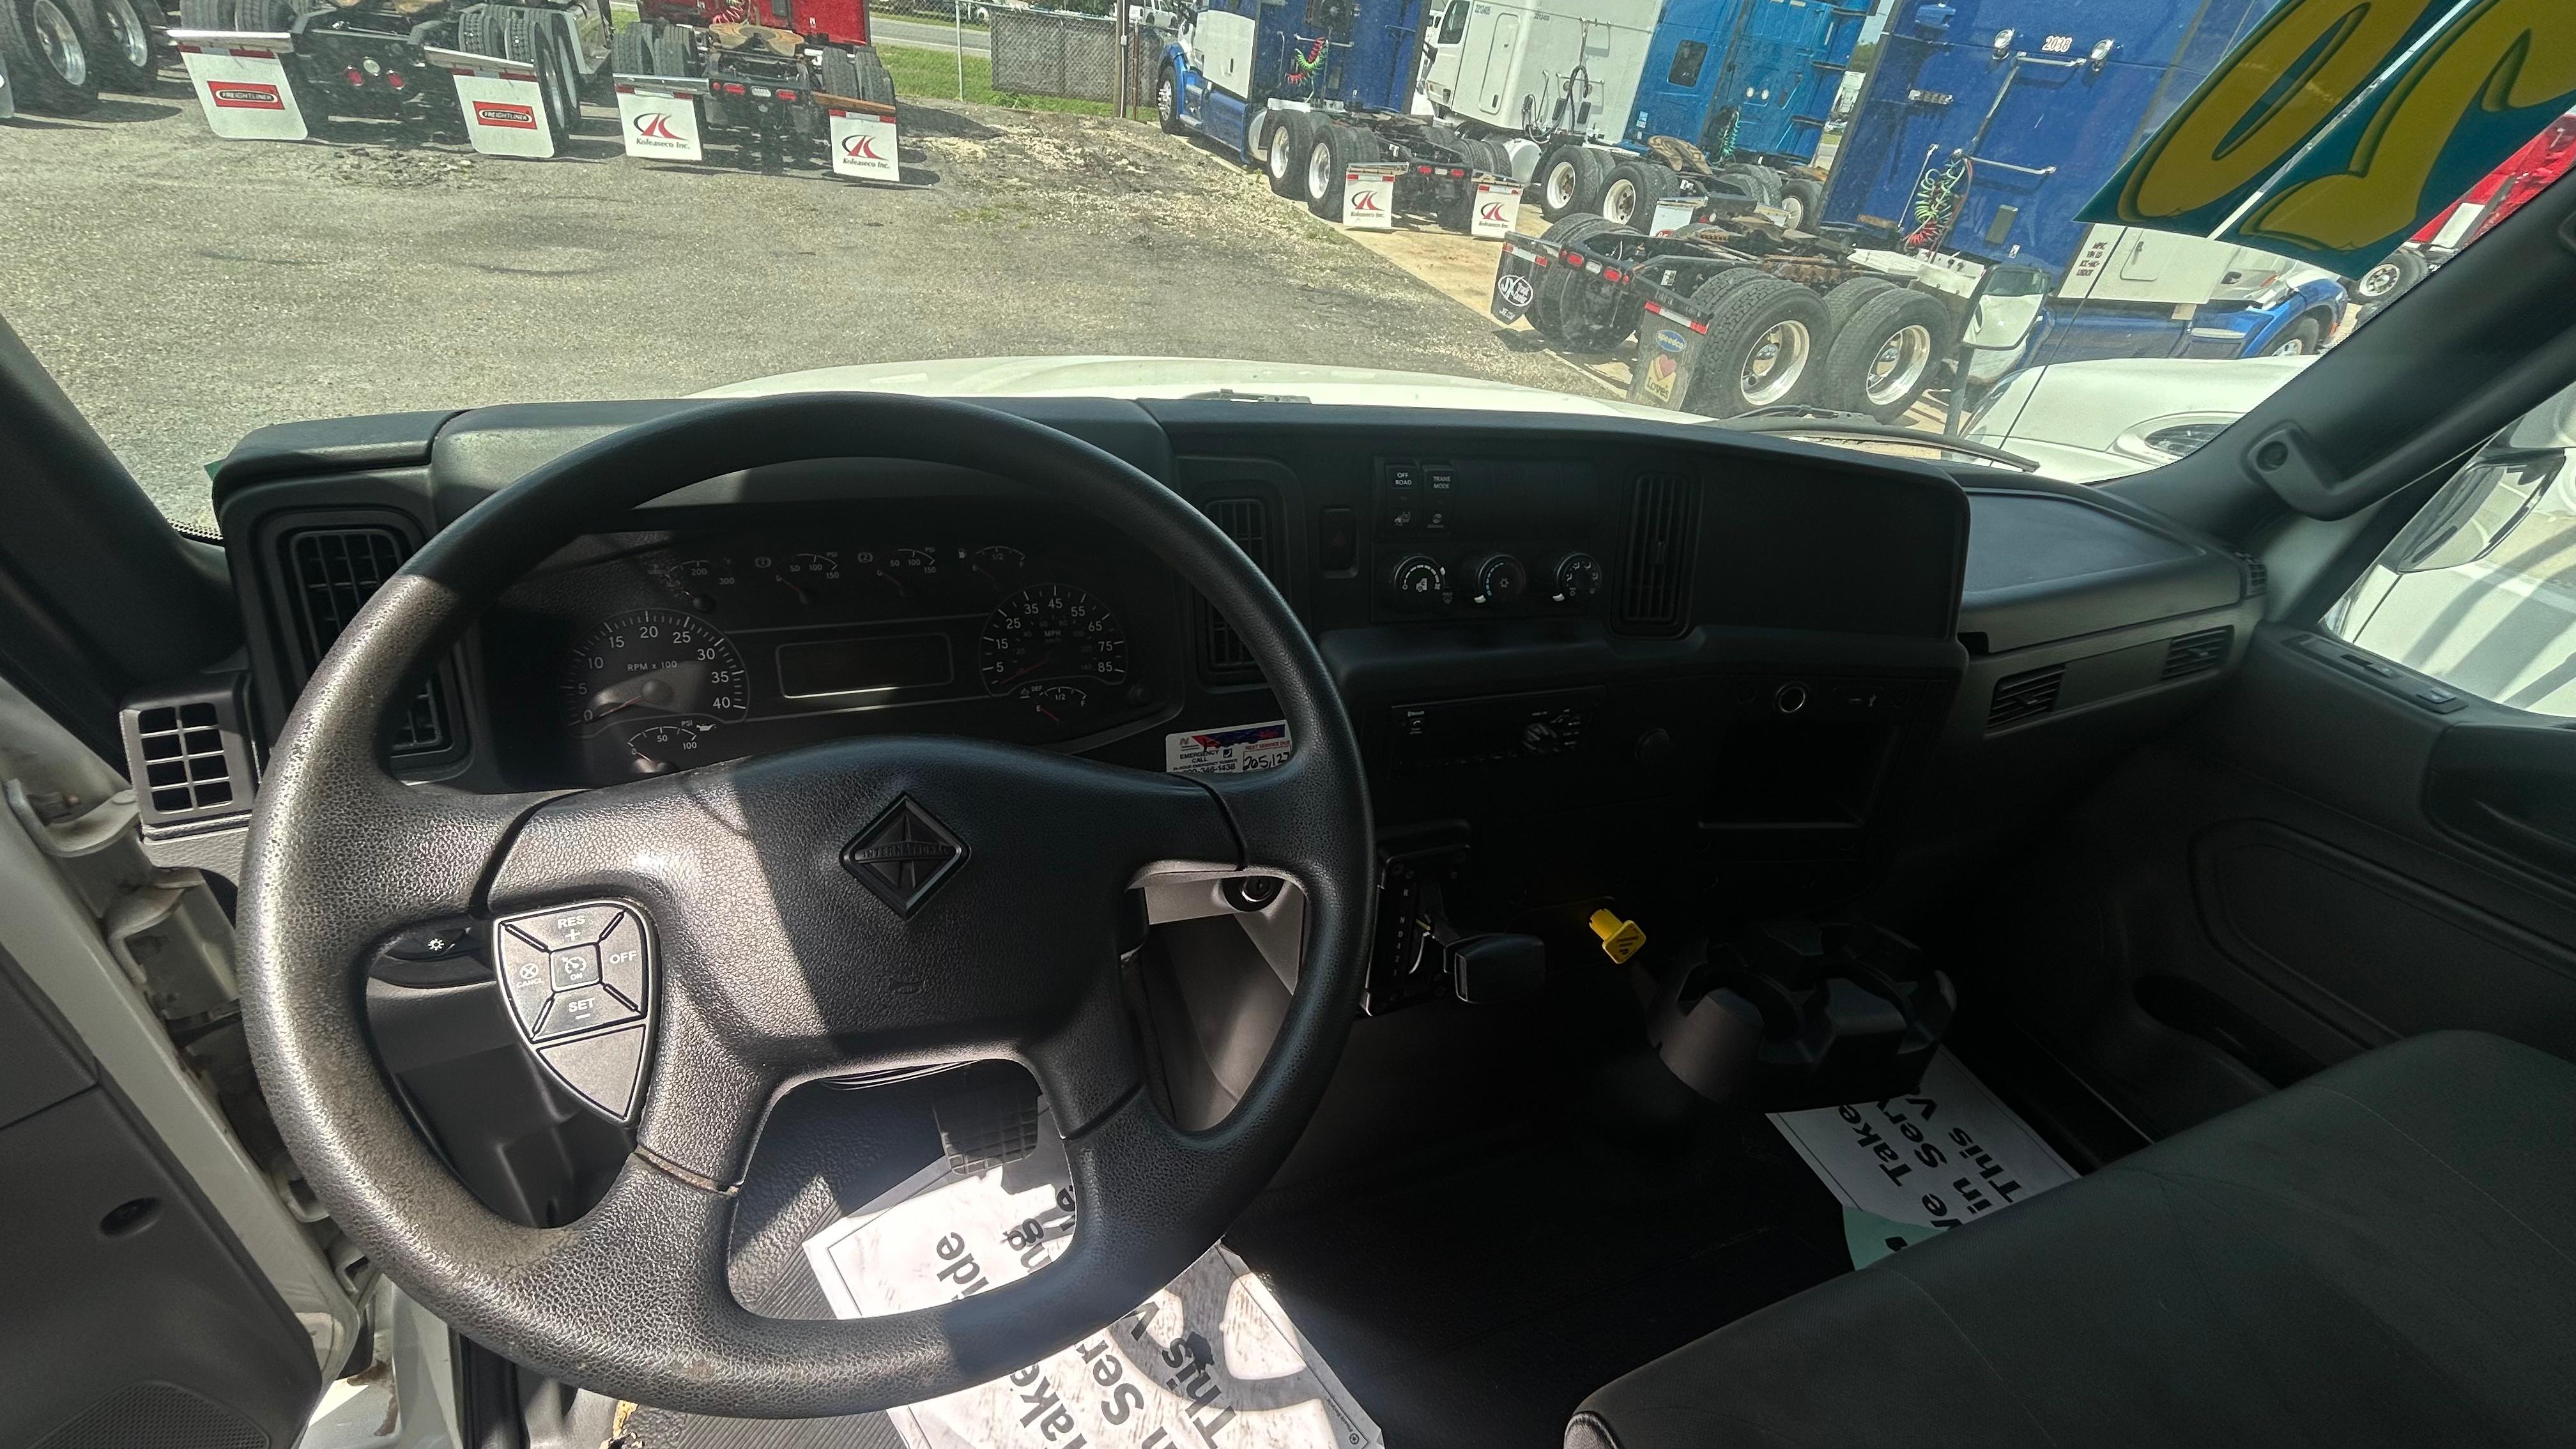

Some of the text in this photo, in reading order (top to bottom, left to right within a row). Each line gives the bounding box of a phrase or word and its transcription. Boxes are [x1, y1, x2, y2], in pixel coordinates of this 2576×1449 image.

[2041, 36, 2073, 52] 2038
[484, 112, 527, 120] FREIGHTLINER
[636, 138, 674, 148] Koleaseco
[843, 158, 876, 167] Koleaseco
[718, 577, 735, 585] 300
[1023, 603, 1039, 615] 35
[1048, 598, 1063, 609] 45
[1071, 606, 1085, 617] 55
[1006, 618, 1022, 629] 25
[1088, 621, 1103, 632] 65
[639, 625, 659, 639] 20
[673, 631, 691, 644] 25
[609, 636, 625, 648] 15
[996, 638, 1009, 650] 15
[1098, 640, 1114, 652] 75
[697, 648, 716, 661] 30
[587, 657, 604, 670] 10
[627, 663, 648, 671] RPM
[661, 660, 678, 669] 100
[996, 661, 1004, 673] 5
[1098, 661, 1113, 672] 85
[711, 671, 730, 684] 35
[578, 683, 588, 695] 5
[712, 696, 731, 709] 40
[583, 709, 594, 721] 0
[682, 742, 698, 750] 100
[557, 915, 586, 929] RES
[610, 951, 637, 964] OFF
[570, 972, 583, 981] ON
[516, 978, 545, 988] CANCL
[568, 997, 595, 1013] SET
[1839, 1105, 1912, 1186] Take
[1949, 1128, 2022, 1202] This
[1953, 1177, 1992, 1213] in
